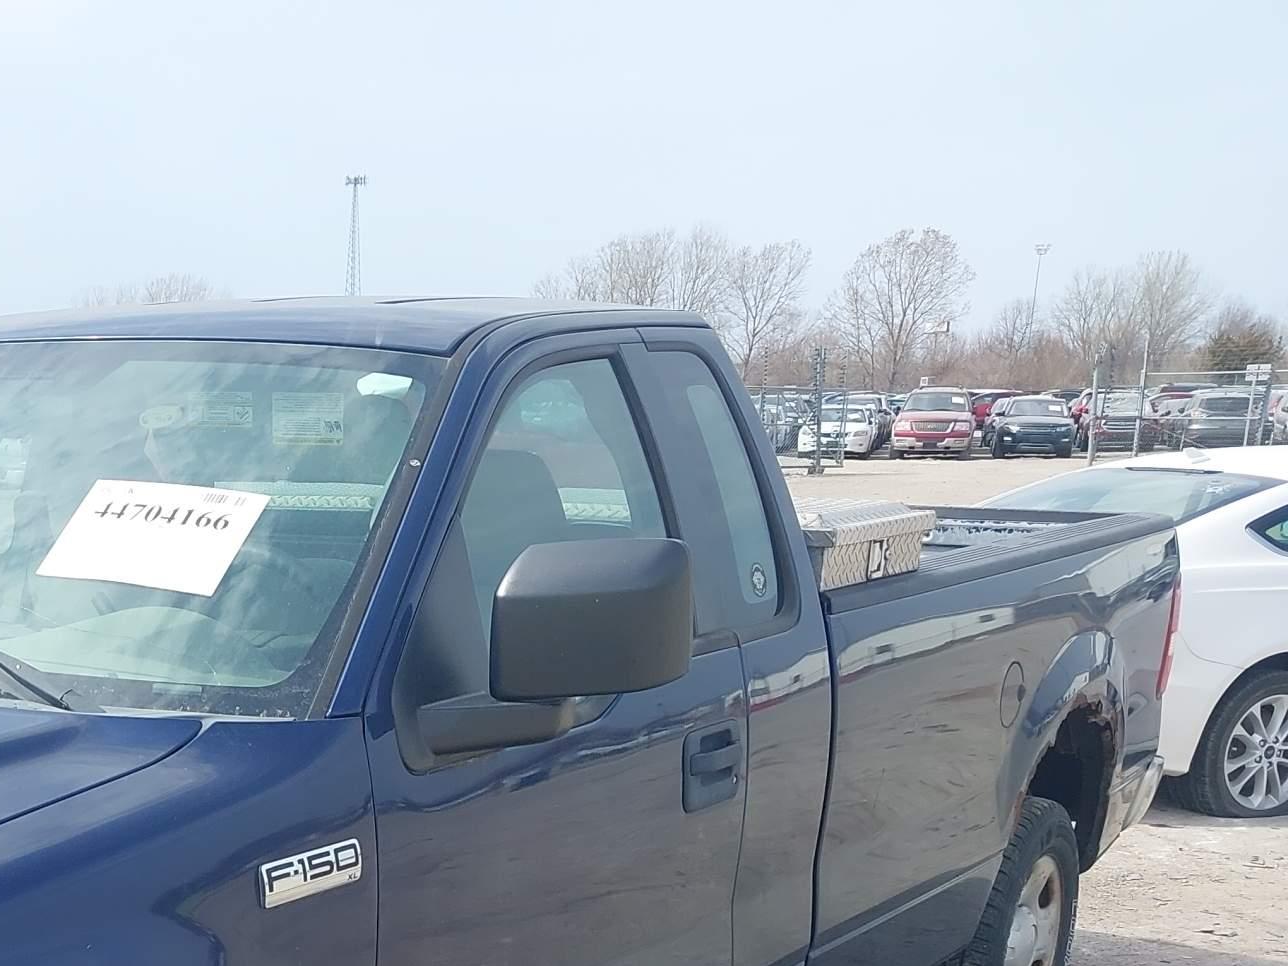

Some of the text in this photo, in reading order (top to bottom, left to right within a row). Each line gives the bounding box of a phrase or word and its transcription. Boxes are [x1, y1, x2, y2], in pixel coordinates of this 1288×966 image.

[94, 501, 232, 530] 44704166
[265, 843, 359, 893] F-150
[347, 873, 357, 881] XL
